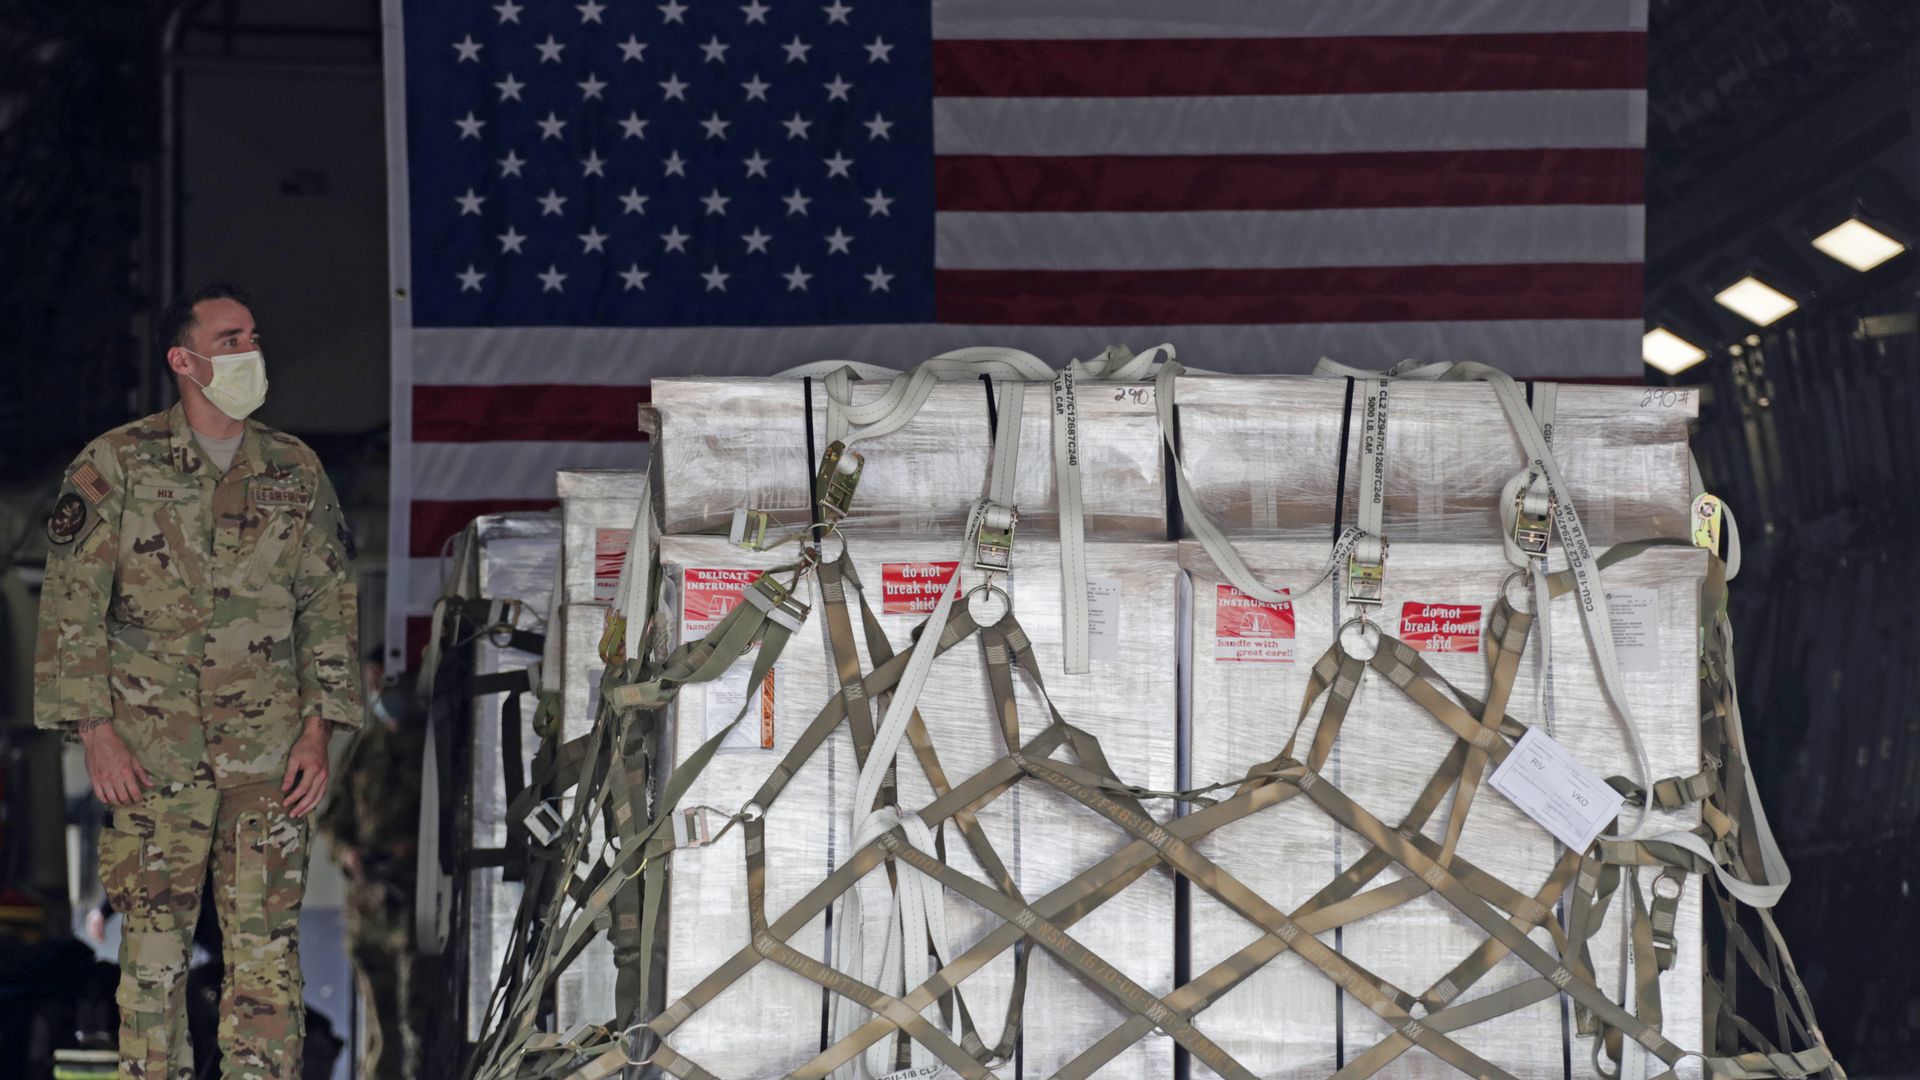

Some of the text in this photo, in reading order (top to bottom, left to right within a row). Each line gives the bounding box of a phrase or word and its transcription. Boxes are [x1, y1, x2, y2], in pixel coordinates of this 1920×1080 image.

[1114, 387, 1155, 405] 290
[1379, 390, 1388, 409] CL2
[1367, 396, 1376, 417] 5000
[157, 489, 174, 499] HIX
[1576, 540, 1591, 560] 5000
[1569, 550, 1582, 567] CL2
[699, 571, 750, 580] DELICATE
[902, 564, 941, 578] do not
[687, 582, 753, 591] INSTRUMEN
[886, 580, 949, 595] break dow
[1578, 571, 1594, 612] CGU-1/B
[910, 597, 935, 611] skid
[1422, 605, 1461, 619] do not
[686, 623, 715, 631] handl
[1404, 618, 1476, 634] break down
[1217, 640, 1252, 648] handle
[1426, 635, 1452, 649] skid
[1237, 649, 1293, 657] great care!!
[1530, 757, 1546, 771] RIV
[1571, 790, 1589, 807] VKO
[920, 1065, 938, 1076] CL2
